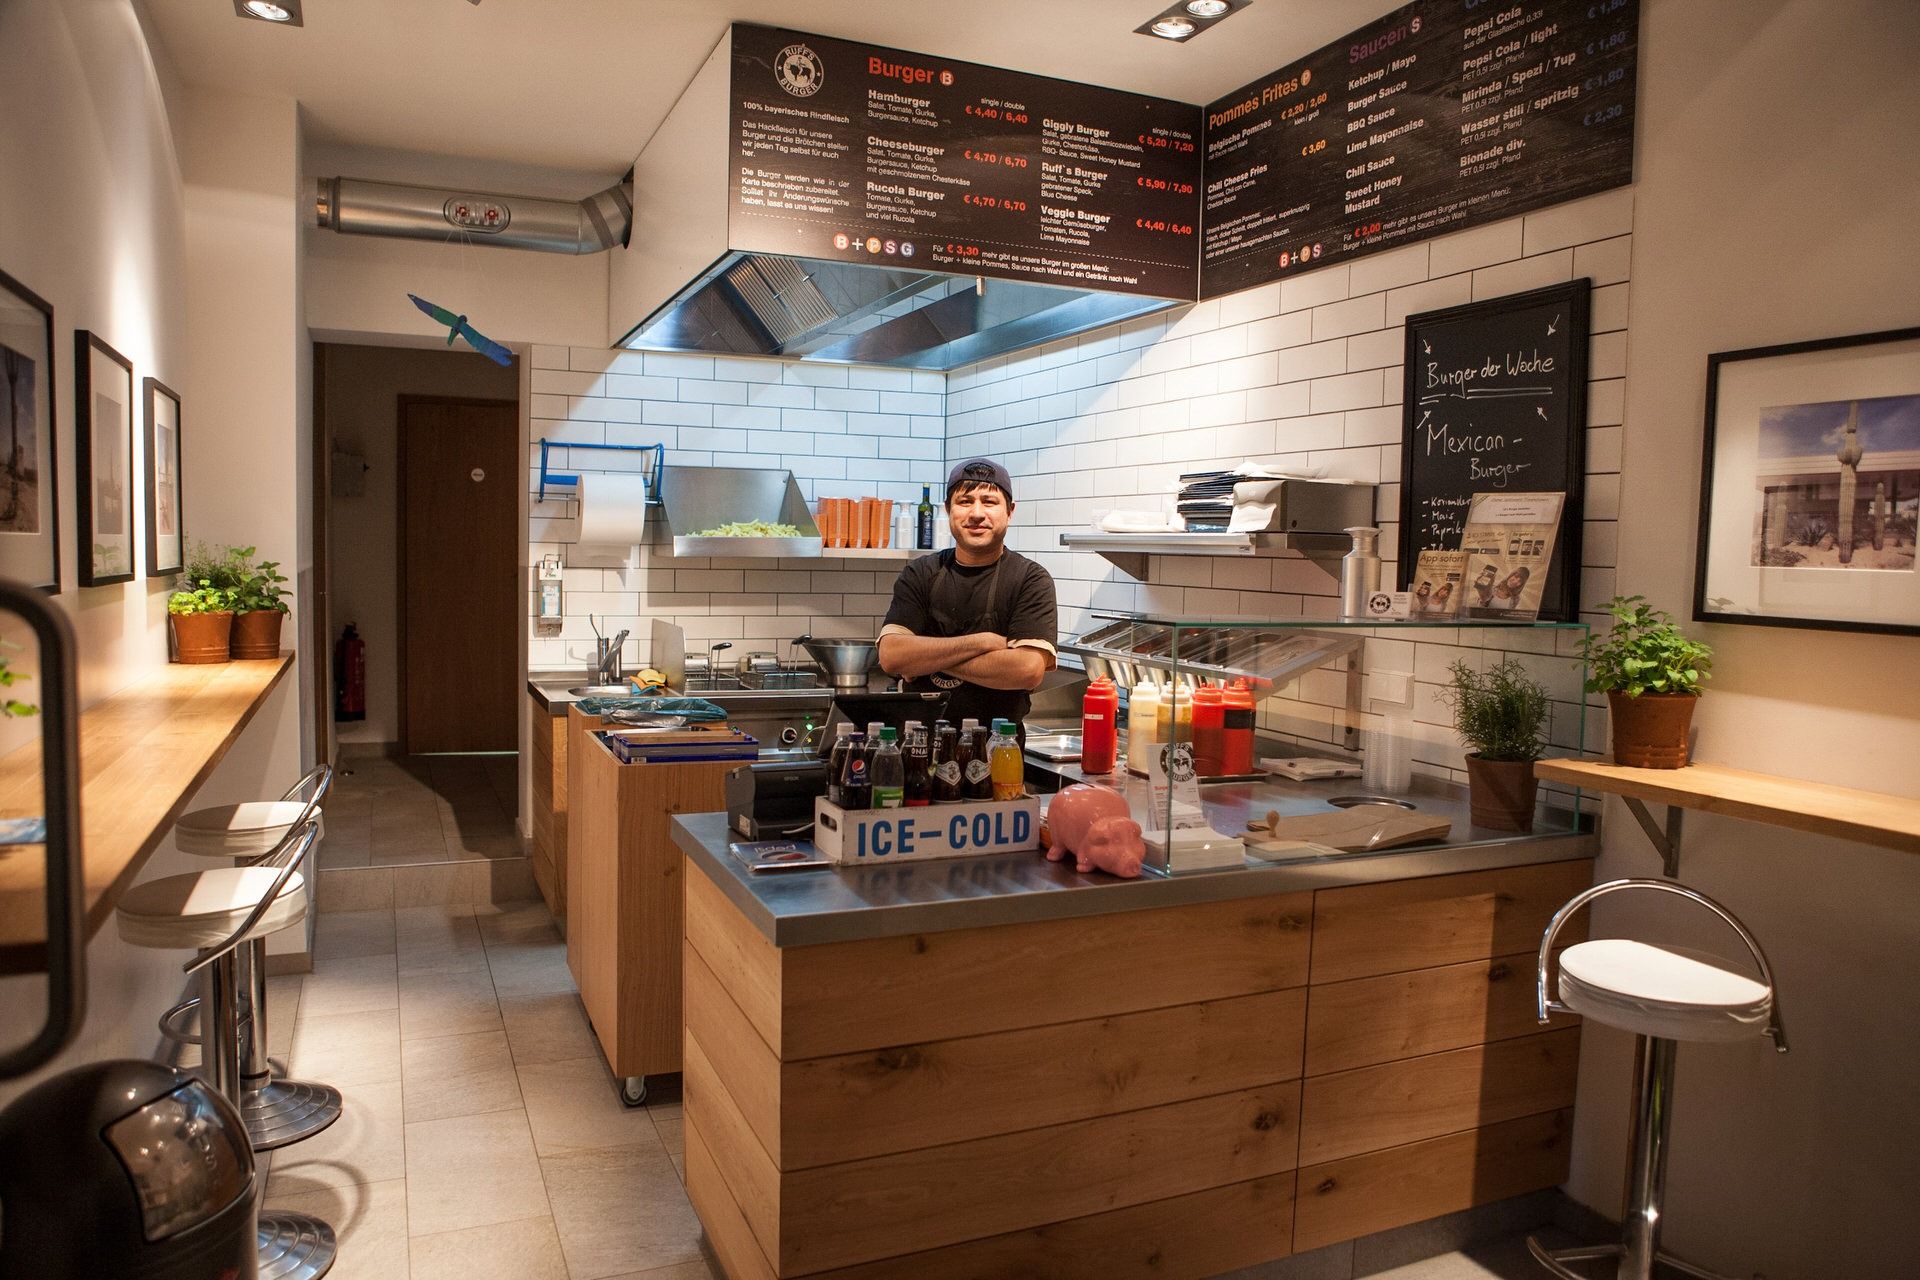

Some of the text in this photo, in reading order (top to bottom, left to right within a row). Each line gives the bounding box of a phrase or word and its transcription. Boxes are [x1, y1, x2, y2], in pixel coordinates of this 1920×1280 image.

[1464, 6, 1521, 40] Pepsi Cola
[1350, 24, 1406, 64] Saucen
[1463, 23, 1557, 72] Pepsi Cola light
[869, 57, 934, 85] Burger
[1348, 54, 1416, 91] Ketchup Mayo
[1462, 52, 1576, 103] Mirinda Spezi 7up
[780, 77, 818, 95] BURGER
[1348, 80, 1406, 112] Burger Sauce
[868, 89, 930, 108] Hamburger
[981, 97, 1025, 110] single double
[1210, 95, 1258, 130] Pommes
[1263, 77, 1298, 105] Frites
[1282, 92, 1326, 120] € 2,20 2,60
[743, 101, 849, 123] 100% bayerisches Rindfleisch
[868, 110, 938, 128] Burgersauce, Ketchup
[966, 105, 1027, 124] € 4,40 6,40
[1347, 107, 1395, 133] BBQ Sauce
[1461, 85, 1578, 135] Wasser still spritzig
[742, 120, 756, 128] Das
[758, 122, 797, 134] Hackfleisch
[799, 128, 808, 136] für
[1043, 118, 1109, 138] Giggly Burger
[1209, 132, 1240, 153] Belgische
[1242, 118, 1271, 138] Pommes
[1347, 118, 1424, 154] Lime Mayonnaise
[742, 129, 766, 140] Burger
[795, 137, 825, 148] Brötchen
[827, 142, 848, 151] stellen
[754, 141, 773, 150] jeden
[775, 144, 788, 153] Tag
[790, 146, 810, 155] selbst
[868, 136, 944, 156] Cheeseburger
[1139, 135, 1193, 152] € 5,20 7,20
[1302, 139, 1326, 156] € 3,60
[742, 149, 755, 157] her.
[965, 150, 1026, 168] € 4,70 6,70
[1460, 138, 1526, 167] Bionade div.
[867, 156, 937, 173] Burgersauce, Ketchup
[1042, 162, 1107, 181] Ruff`s Burger
[1346, 155, 1394, 179] Chili Sauce
[1138, 177, 1192, 194] € 5,90 7,90
[1208, 164, 1267, 193] Chili Cheese Fries
[1345, 174, 1402, 200] Sweet Honey
[866, 193, 915, 206] Tomate, Gurke,
[867, 181, 944, 201] Rucola Burger
[1041, 190, 1077, 201] Blue Cheese
[866, 202, 936, 218] Burgersauce, Ketchup
[964, 195, 1025, 211] € 4,70 6,70
[1345, 194, 1379, 214] Mustard
[892, 214, 914, 223] Rucola
[1041, 205, 1110, 224] Veggie Burger
[1136, 219, 1191, 234] € 4,40 6,40
[1040, 233, 1090, 246] Lime Mayonnaise
[947, 244, 953, 253] €
[957, 245, 978, 256] 3,30
[1041, 258, 1060, 267] Burger
[1071, 262, 1090, 270] großen
[1092, 264, 1109, 272] Menü:
[1427, 348, 1555, 398] Burger der Woche
[1427, 423, 1504, 456] Mexican
[1470, 458, 1531, 488] Burger
[1432, 510, 1455, 520] Mais
[1420, 554, 1464, 566] App sofort
